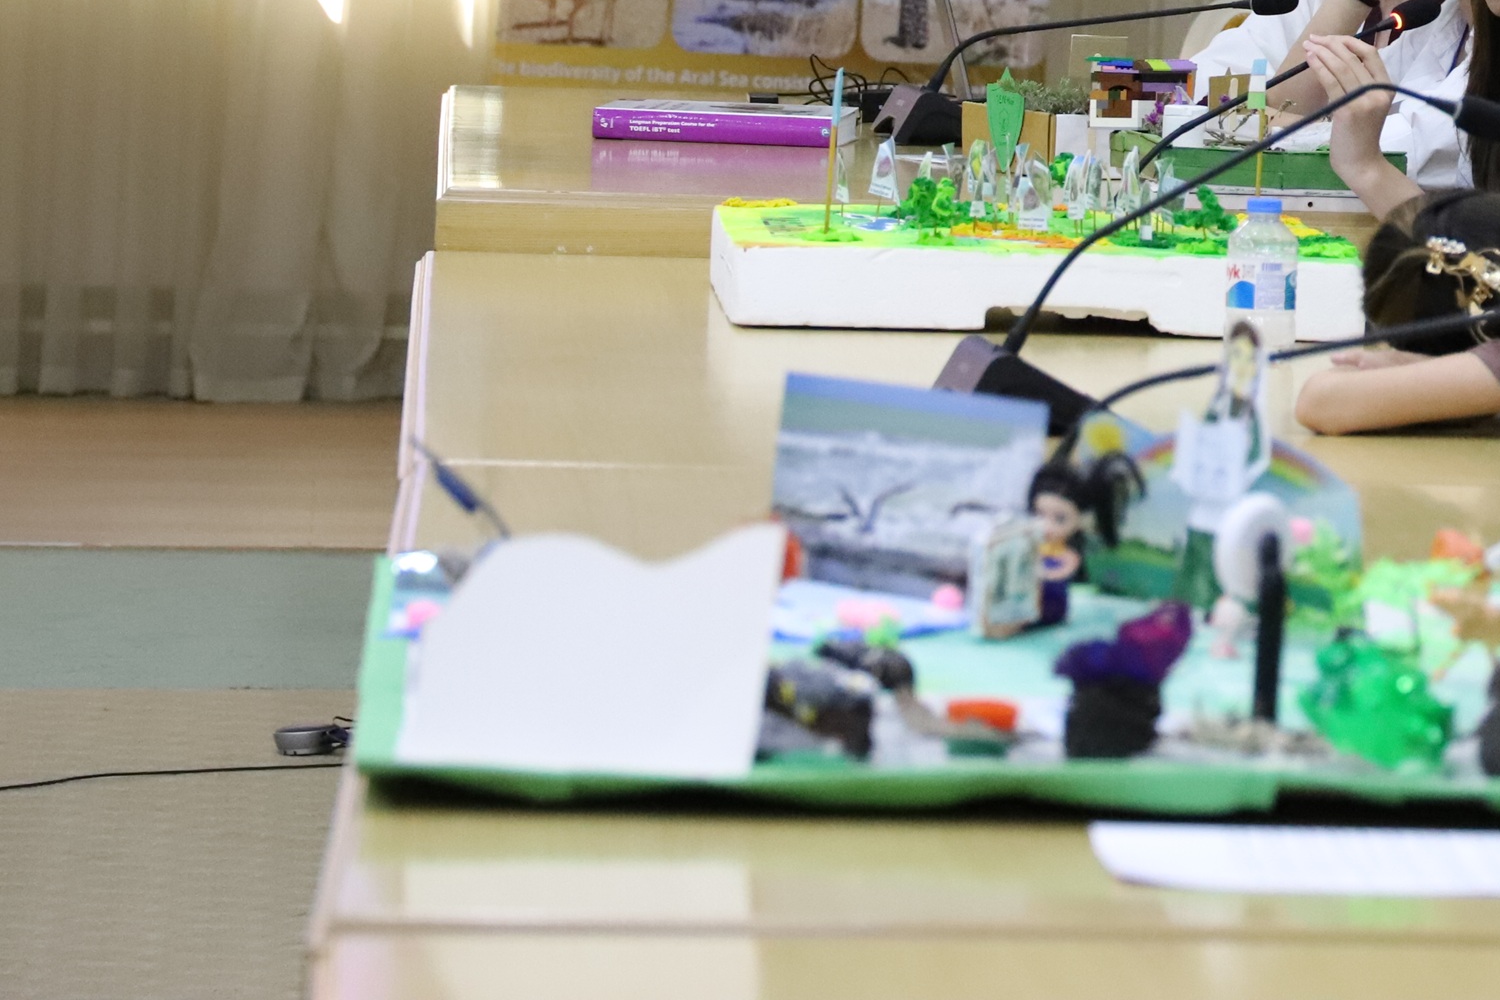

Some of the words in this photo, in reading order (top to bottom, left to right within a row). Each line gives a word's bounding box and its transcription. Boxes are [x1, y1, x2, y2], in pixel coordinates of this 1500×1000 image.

[519, 61, 621, 84] biodiversity
[624, 65, 644, 82] of
[647, 67, 675, 84] the
[680, 69, 715, 86] Aral
[718, 71, 749, 88] Sea
[652, 120, 681, 128] Preparation
